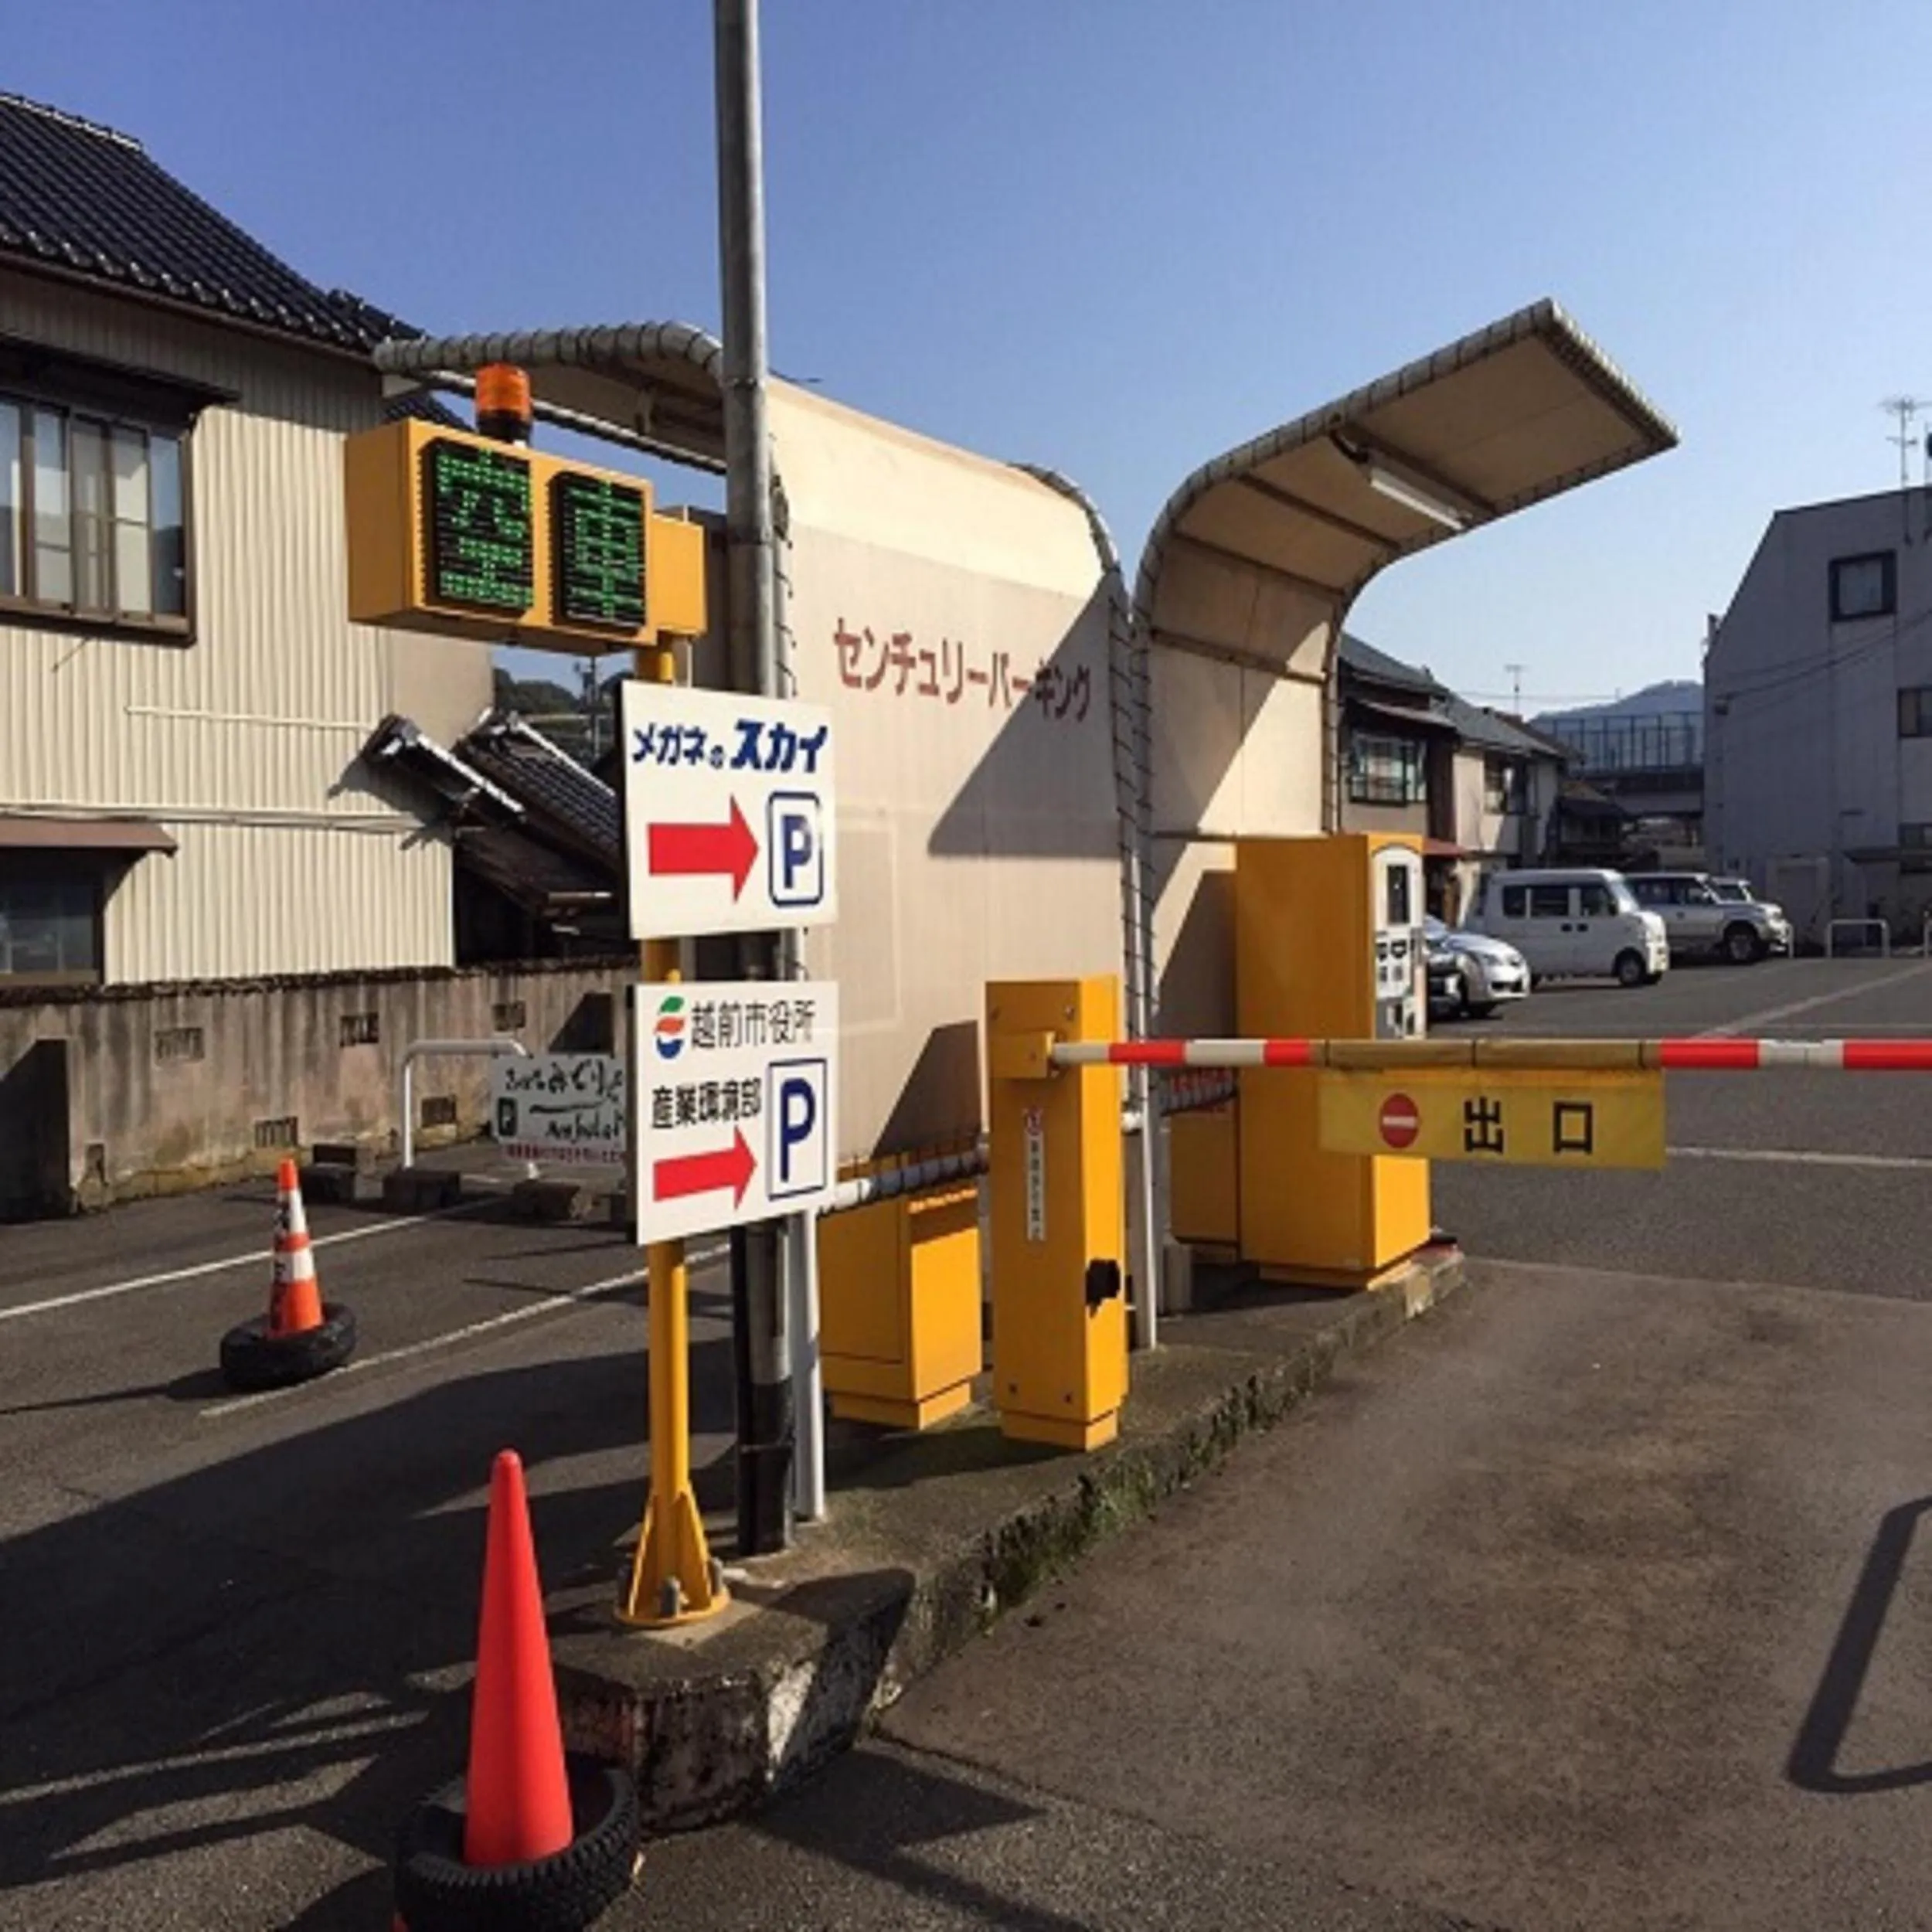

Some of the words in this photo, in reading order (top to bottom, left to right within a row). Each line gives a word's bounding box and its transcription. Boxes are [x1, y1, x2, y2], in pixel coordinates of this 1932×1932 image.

[781, 814, 813, 889] P
[691, 999, 815, 1048] 越前市役所
[781, 1078, 816, 1182] P
